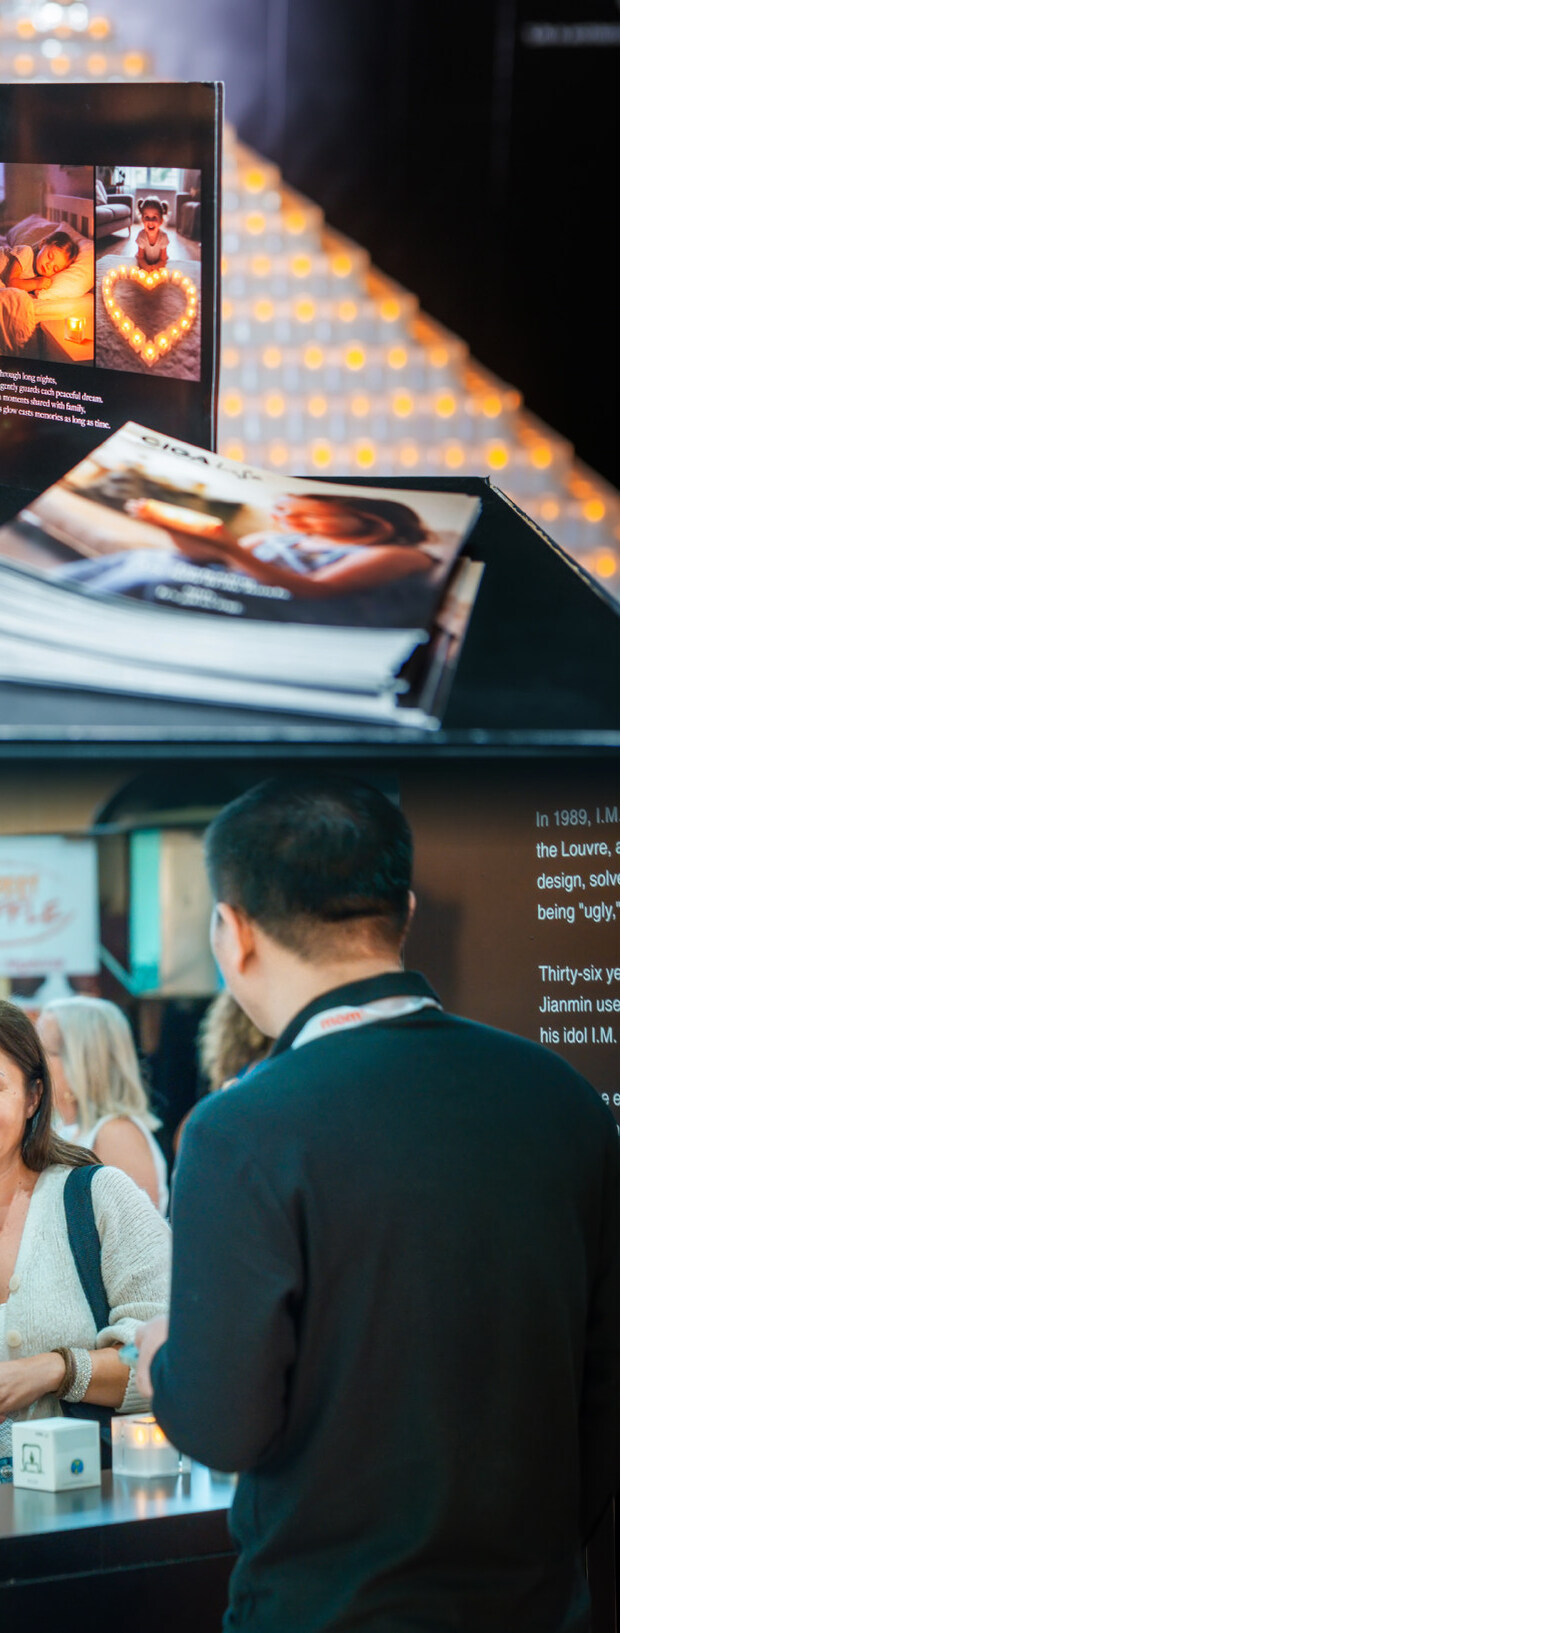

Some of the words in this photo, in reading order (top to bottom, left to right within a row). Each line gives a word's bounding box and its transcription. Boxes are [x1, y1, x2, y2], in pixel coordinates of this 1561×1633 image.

[22, 372, 36, 383] long
[36, 374, 57, 385] nights,
[0, 382, 18, 393] gently
[19, 384, 40, 394] guards
[41, 387, 55, 397] each
[55, 389, 81, 400] peaceful
[81, 392, 104, 404] dream.
[2, 394, 30, 404] moments
[30, 397, 51, 407] shared
[51, 400, 65, 410] with
[65, 402, 86, 415] family,
[2, 405, 18, 415] glow
[18, 407, 34, 417] casts
[34, 410, 64, 422] memories
[64, 415, 71, 423] as
[71, 415, 86, 427] long
[86, 419, 94, 427] as
[94, 419, 111, 429] time.
[536, 811, 549, 828] In
[553, 808, 592, 828] 1989,
[536, 841, 558, 858] the
[561, 840, 612, 858] Louvre,
[537, 872, 586, 892] design,
[537, 903, 576, 924] being
[538, 964, 603, 985] Thirty-six
[539, 996, 592, 1013] Jianmin
[540, 1027, 560, 1044] his
[563, 1026, 588, 1044] idol
[592, 1026, 617, 1044] I.M.
